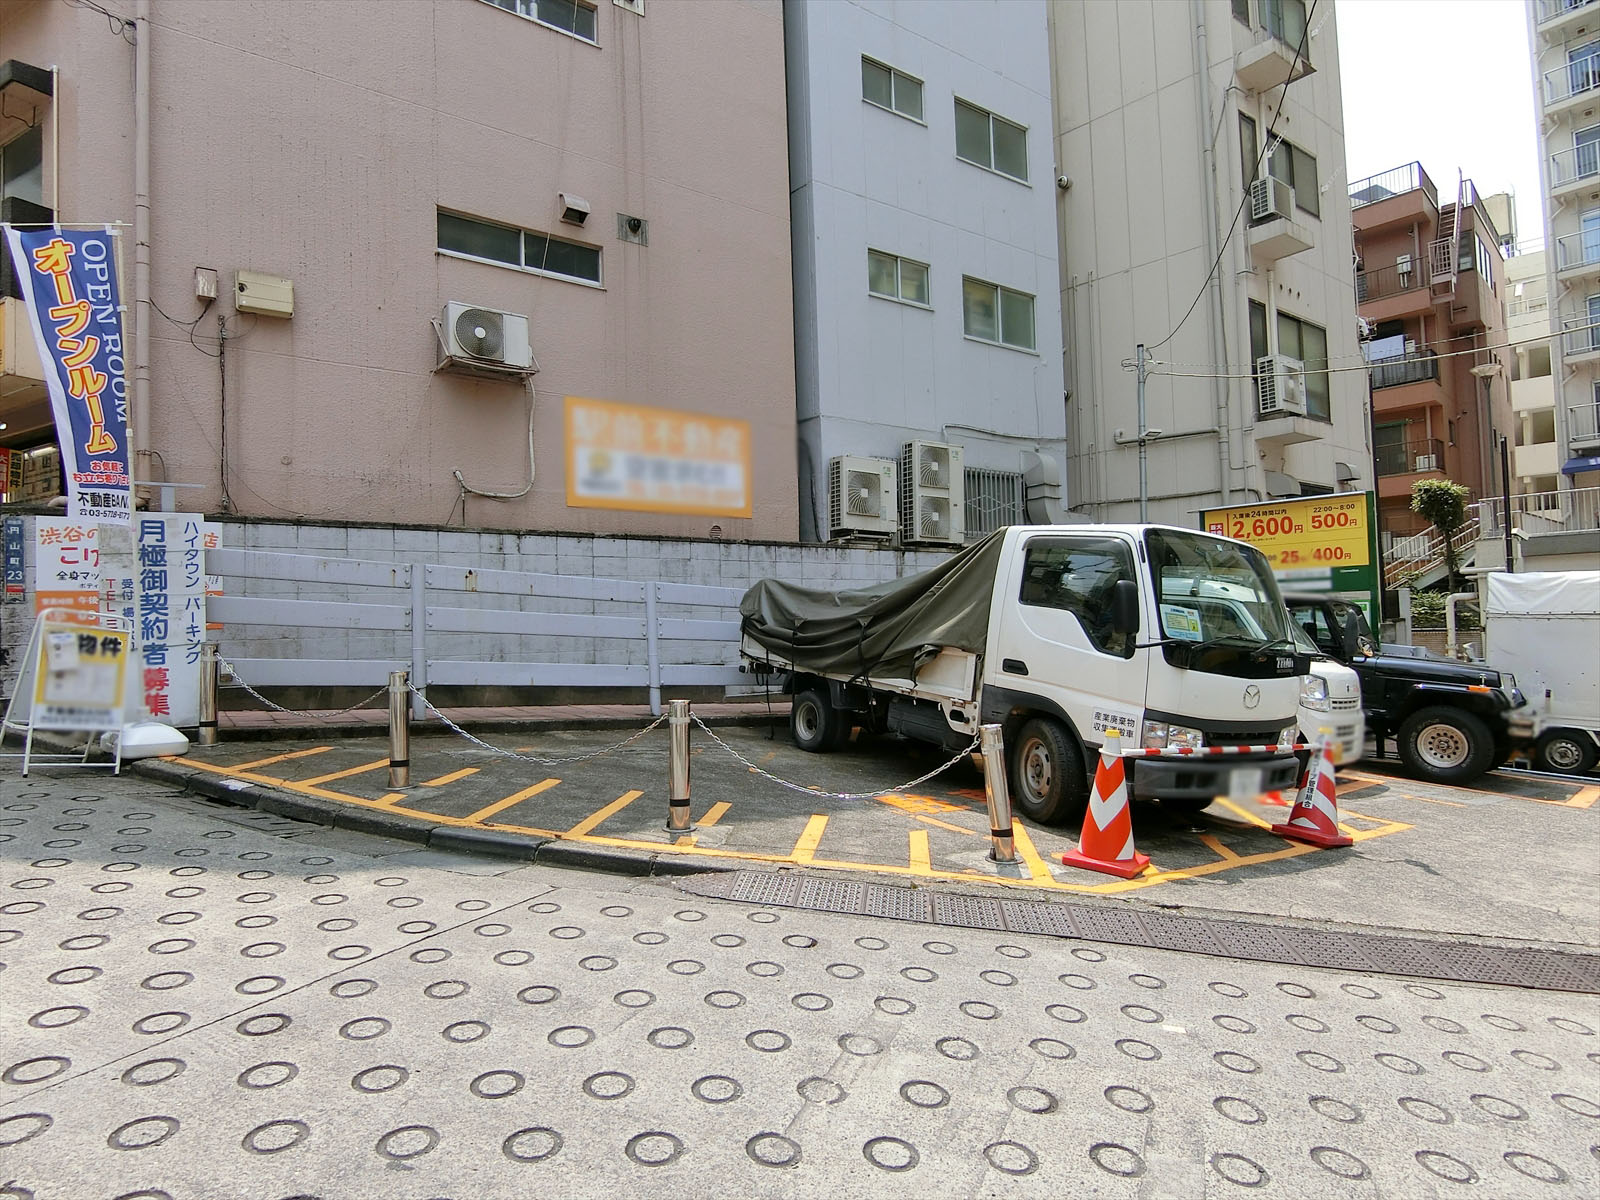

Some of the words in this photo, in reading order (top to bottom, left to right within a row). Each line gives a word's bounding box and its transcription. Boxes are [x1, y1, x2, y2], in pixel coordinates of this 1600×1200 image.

[82, 239, 116, 326] OPEN
[103, 332, 128, 422] ROOM
[34, 237, 117, 454] オープンルーム
[1232, 516, 1304, 538] 2,600円
[1311, 512, 1357, 529] 500円
[10, 526, 20, 565] 円山町
[184, 521, 199, 588] ハイタウン
[1313, 547, 1351, 560] 400円
[7, 570, 23, 580] 23
[105, 579, 116, 612] TEL
[138, 519, 170, 716] 月極御契約者募集
[1093, 722, 1134, 738] 収集搬車
[1094, 712, 1135, 727] 産業廃棄物
